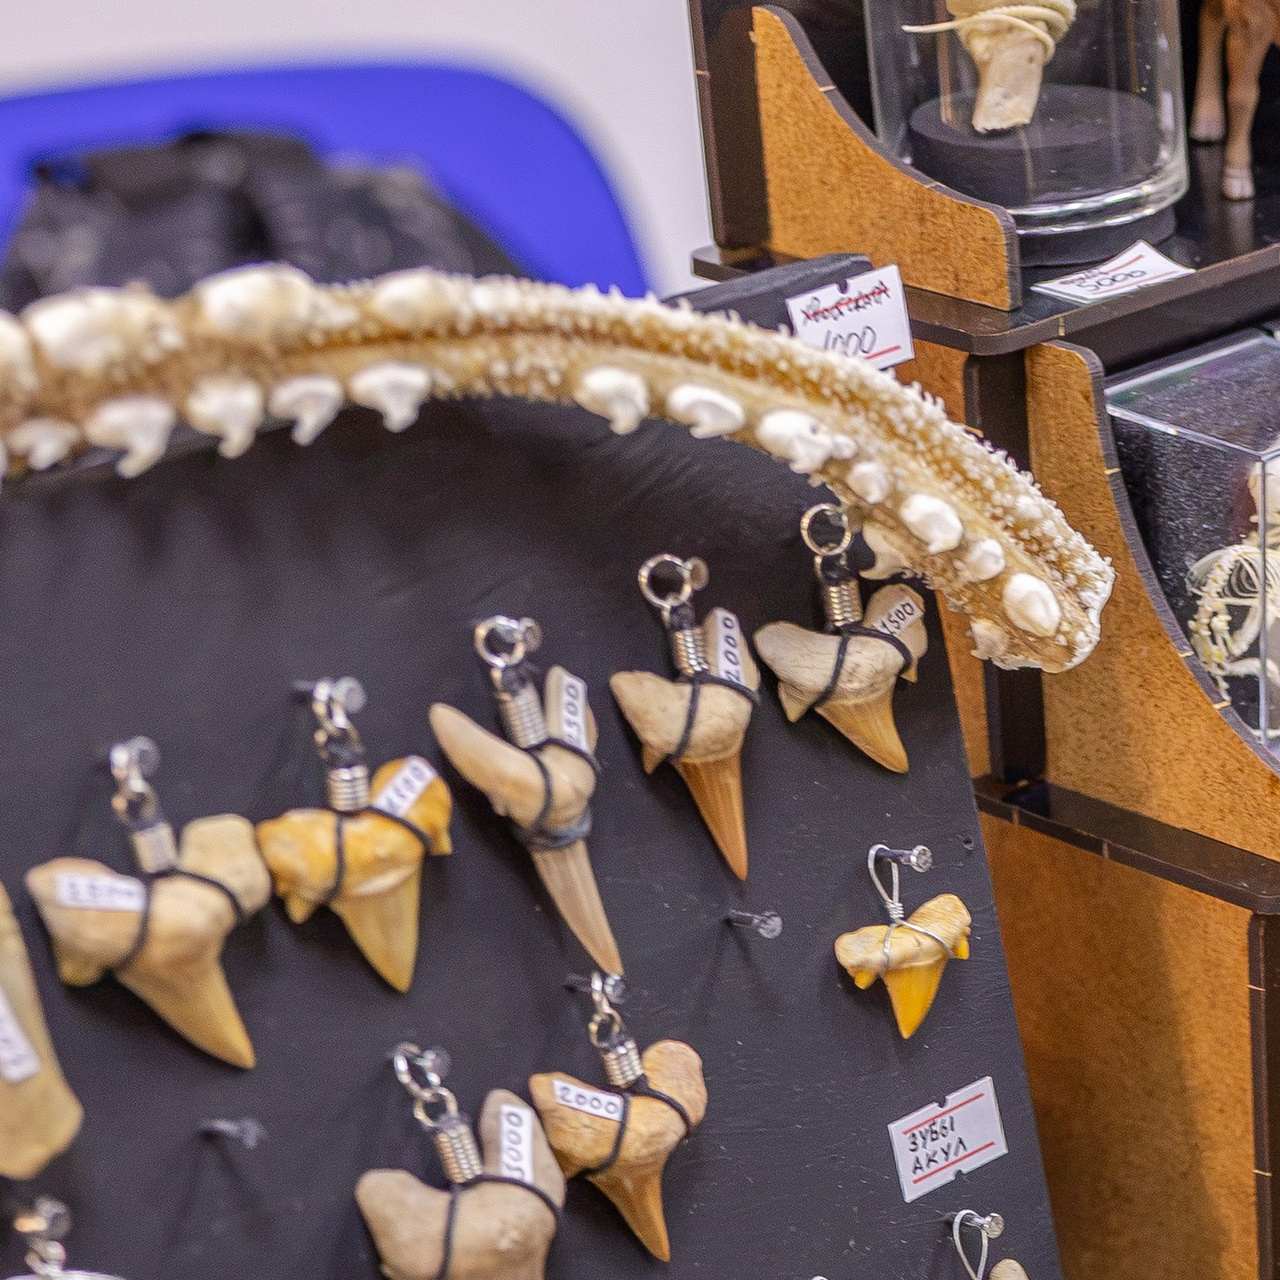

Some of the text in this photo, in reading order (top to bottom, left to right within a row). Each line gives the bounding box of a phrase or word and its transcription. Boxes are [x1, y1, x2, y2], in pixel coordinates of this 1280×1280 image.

[1076, 270, 1147, 291] 5000
[560, 1086, 618, 1114] 2000
[909, 1115, 955, 1153] ЗУБЫ
[912, 1137, 968, 1174] АКУЛ
